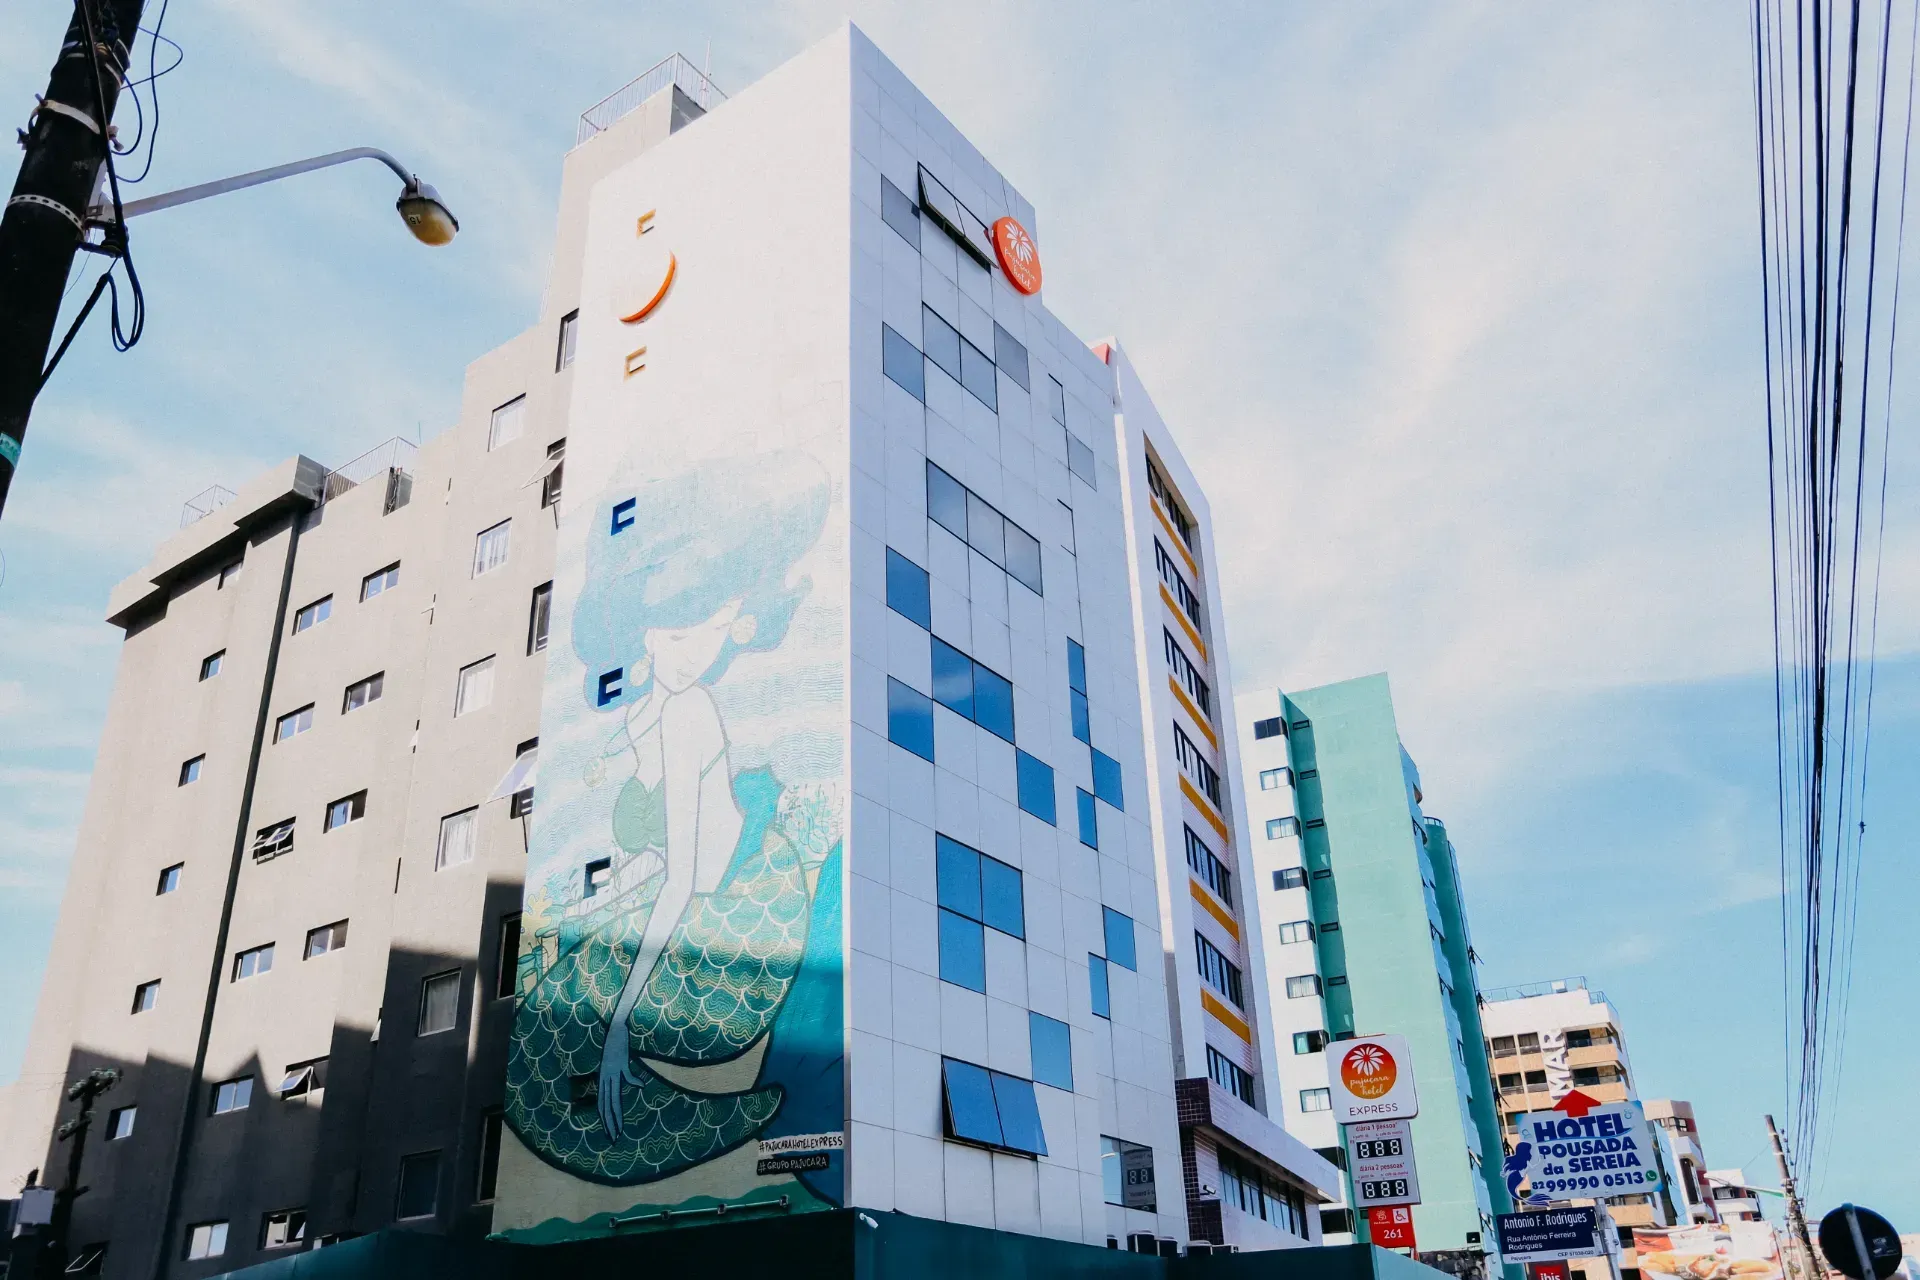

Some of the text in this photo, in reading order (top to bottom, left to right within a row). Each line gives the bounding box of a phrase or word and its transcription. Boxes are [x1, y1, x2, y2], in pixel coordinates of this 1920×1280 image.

[410, 216, 421, 225] 15
[1013, 264, 1032, 290] hotel
[1361, 1084, 1385, 1096] hotel
[1349, 1103, 1399, 1116] EXPRESS
[1533, 1113, 1631, 1143] HOTEL
[1538, 1136, 1637, 1159] POUSADA
[1543, 1152, 1642, 1176] da SEREIA
[1532, 1172, 1644, 1192] 82 99990 0513
[1504, 1212, 1587, 1230] Antonio F. Rodrigues
[1384, 1228, 1403, 1239] 261
[1507, 1235, 1521, 1243] Rua
[1549, 1231, 1577, 1239] Ferreira
[1508, 1242, 1543, 1251] Rodrigues
[1540, 1272, 1560, 1280] ibis
